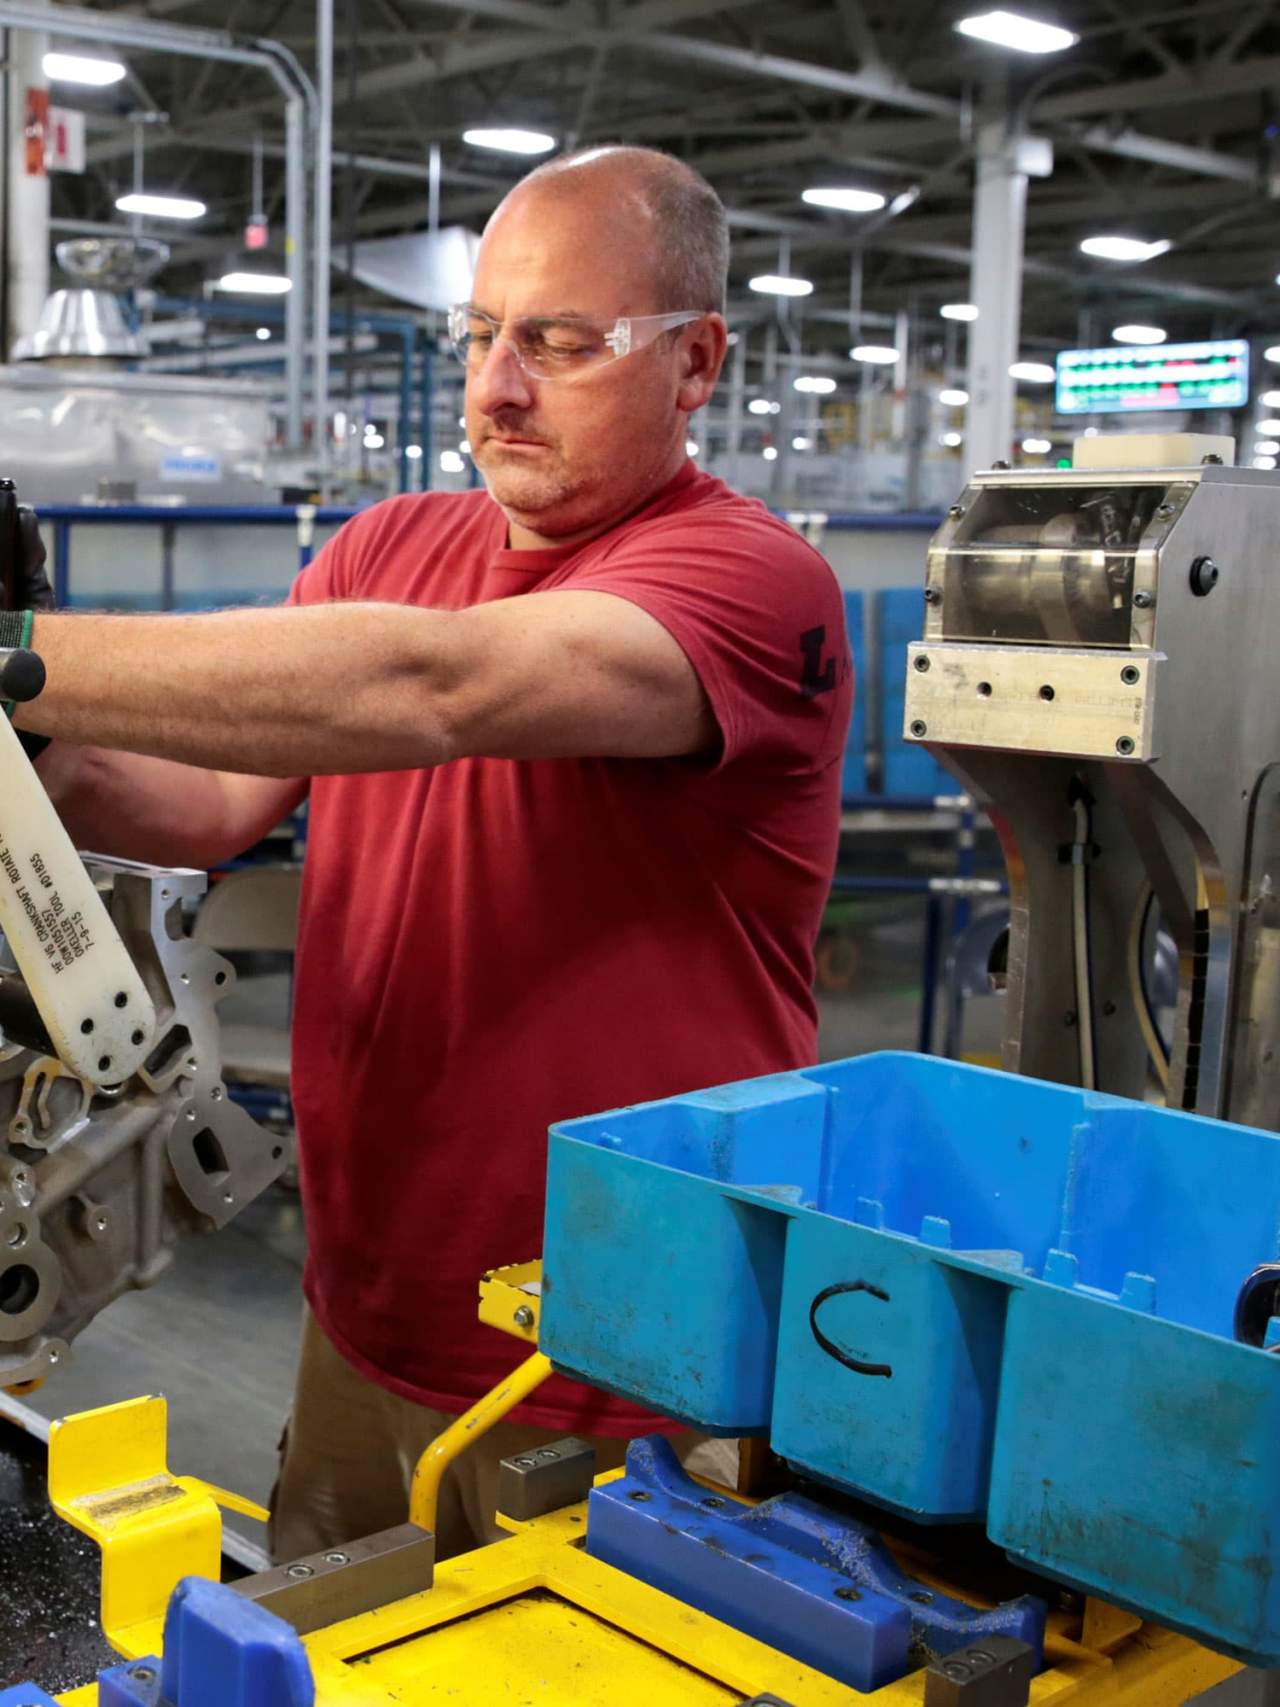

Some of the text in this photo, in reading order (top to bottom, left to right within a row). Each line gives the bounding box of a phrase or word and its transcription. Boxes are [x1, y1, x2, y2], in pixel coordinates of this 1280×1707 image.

[16, 885, 49, 943] CRANKSHAFT
[49, 891, 66, 917] TOOL
[72, 911, 94, 950] 7-9-15
[45, 944, 56, 959] V6
[51, 962, 64, 974] HF
[810, 1280, 892, 1378] C
